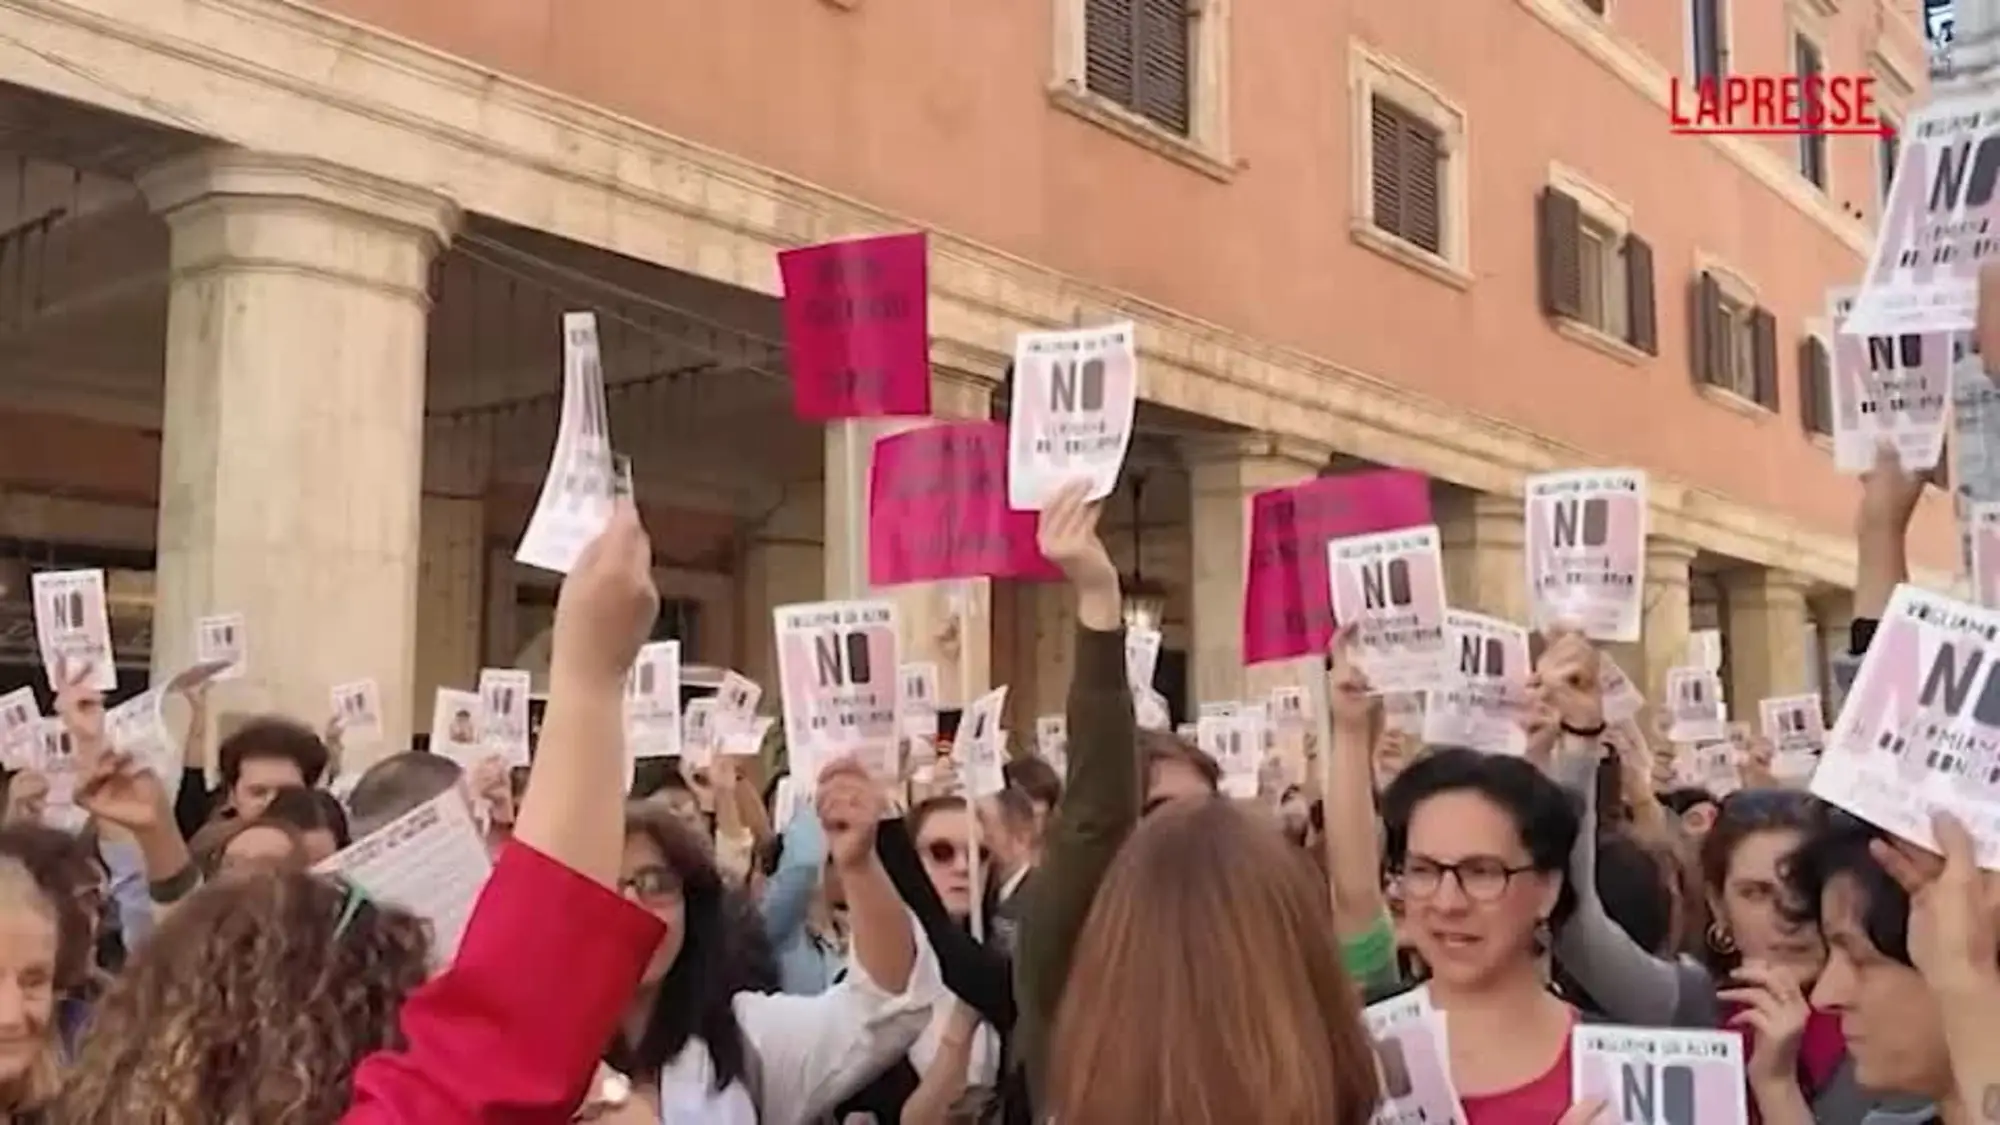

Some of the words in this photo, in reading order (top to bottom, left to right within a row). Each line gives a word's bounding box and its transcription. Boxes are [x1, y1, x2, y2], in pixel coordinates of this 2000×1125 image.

[1051, 359, 1105, 413] NO
[1554, 499, 1608, 547] NO
[1362, 559, 1412, 609] NO
[816, 632, 870, 687] NO
[1460, 634, 1504, 676] NO
[1622, 1061, 1695, 1125] NO
